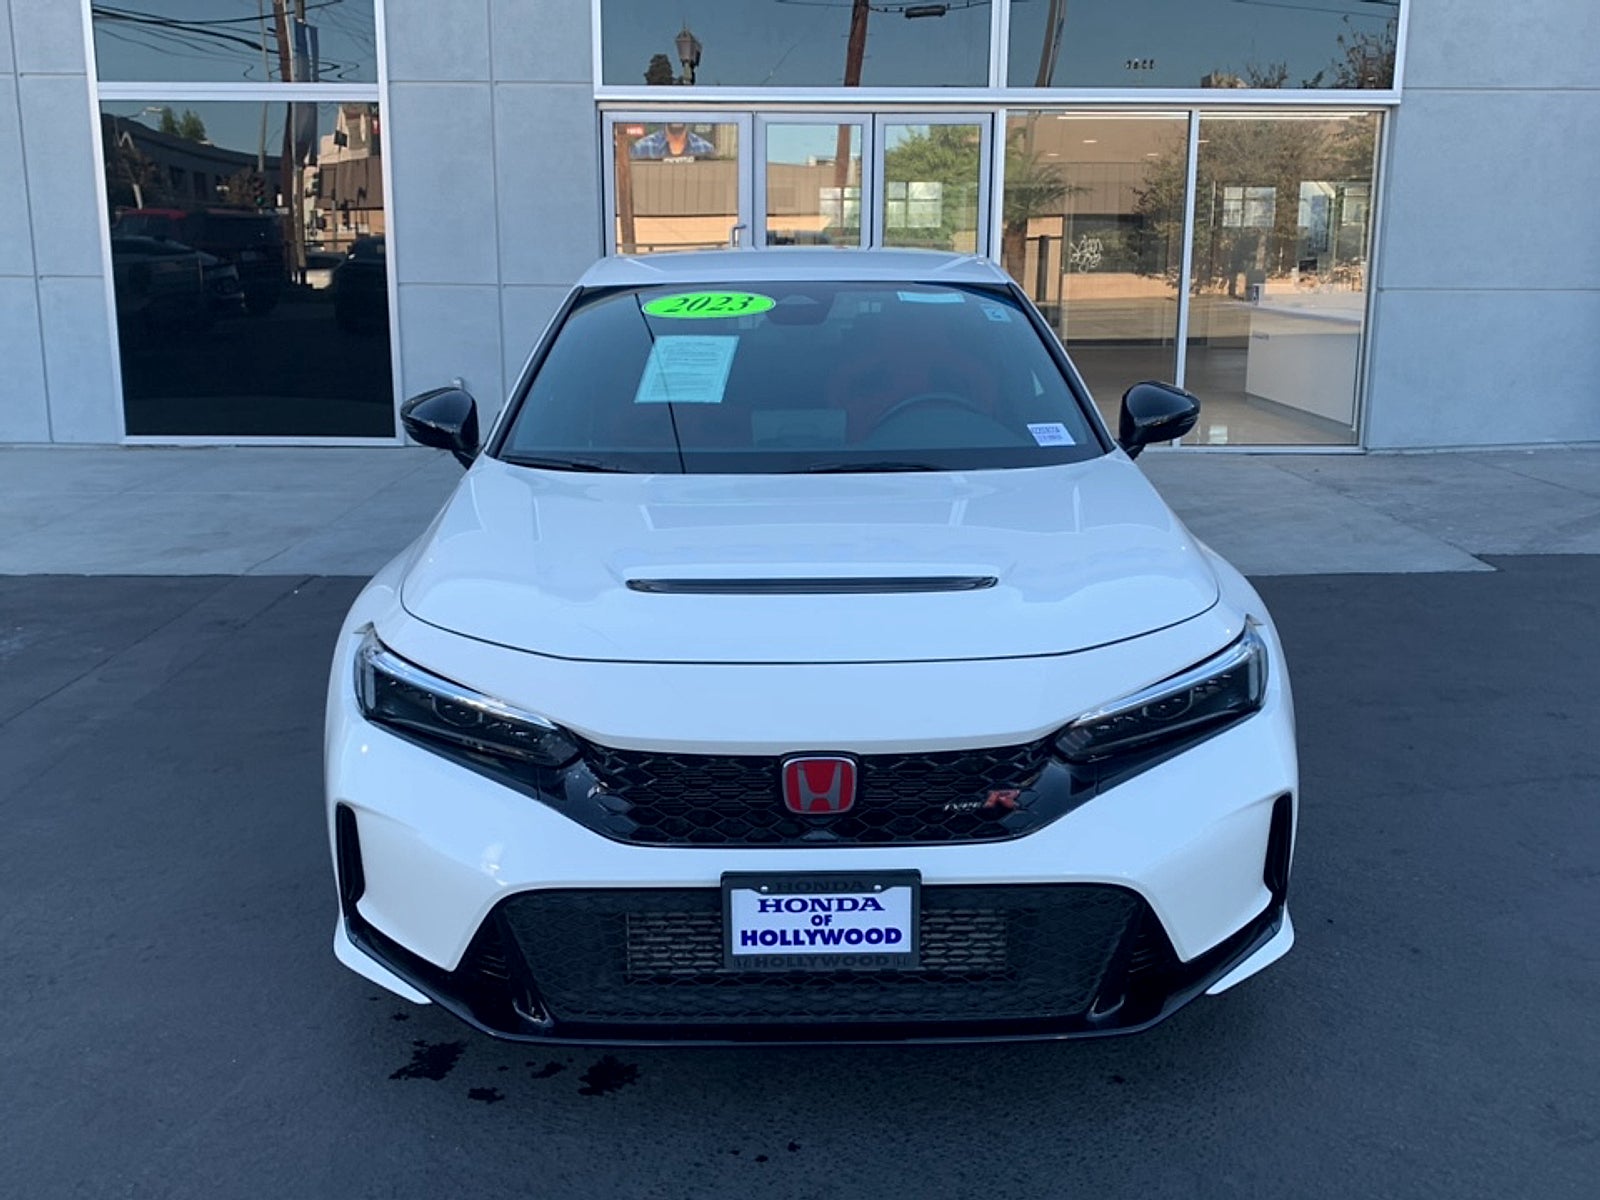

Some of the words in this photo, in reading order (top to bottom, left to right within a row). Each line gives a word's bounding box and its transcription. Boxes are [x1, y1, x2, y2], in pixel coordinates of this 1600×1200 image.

[663, 295, 755, 313] 2023
[775, 880, 866, 892] HONDA
[757, 896, 885, 913] HONDA
[810, 914, 832, 927] OF
[740, 928, 902, 946] HOLLYWOOD
[754, 955, 889, 968] HOLLYWOOD
